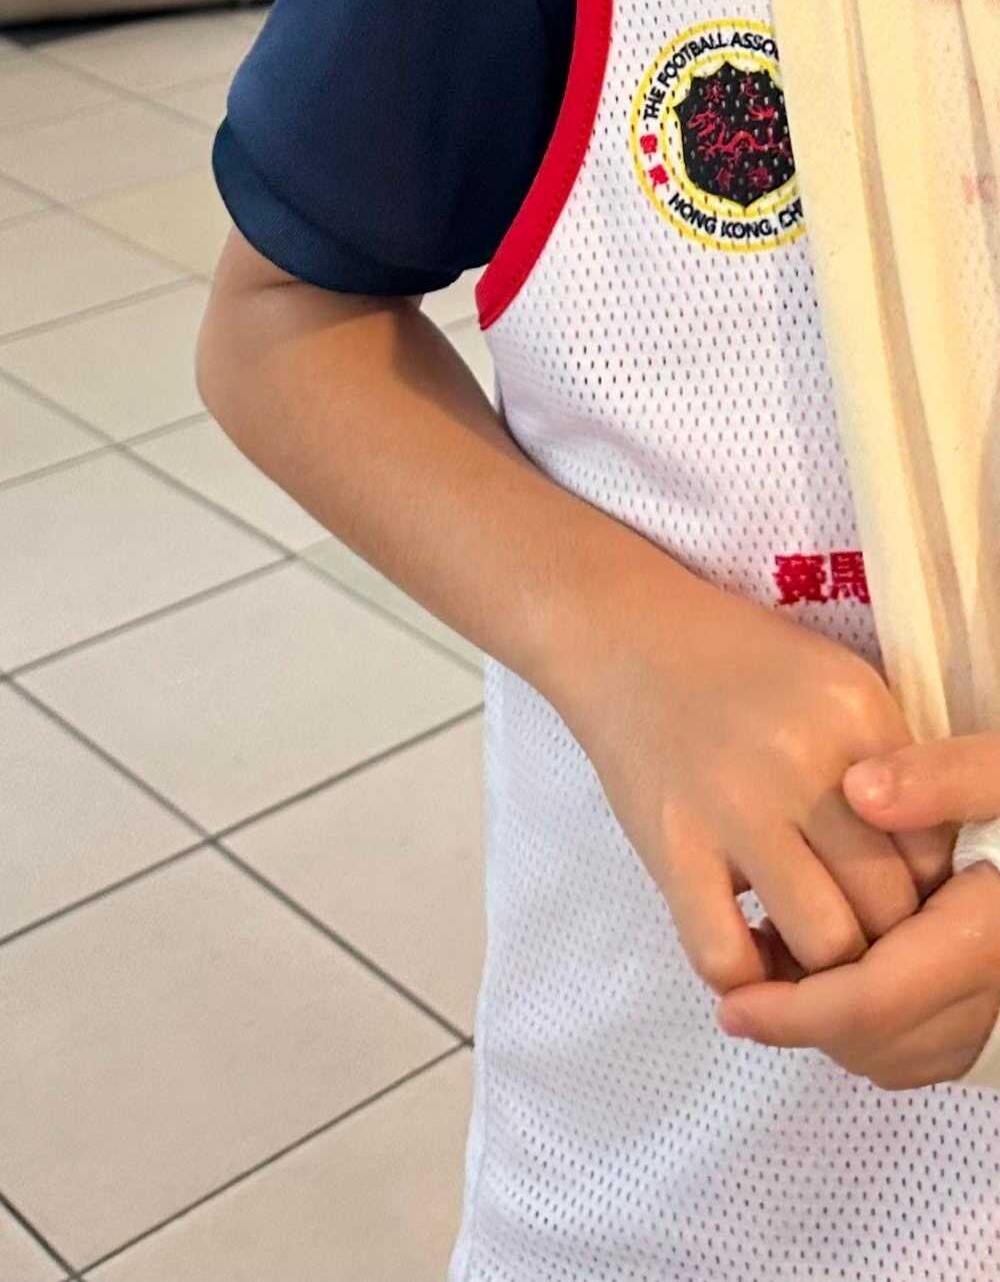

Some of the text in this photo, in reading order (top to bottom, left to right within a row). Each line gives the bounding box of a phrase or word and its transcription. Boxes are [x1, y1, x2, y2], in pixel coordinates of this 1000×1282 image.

[643, 86, 667, 121] THE
[656, 32, 728, 88] FOOTBALL
[668, 192, 718, 235] HONG
[720, 218, 779, 239] KONG,
